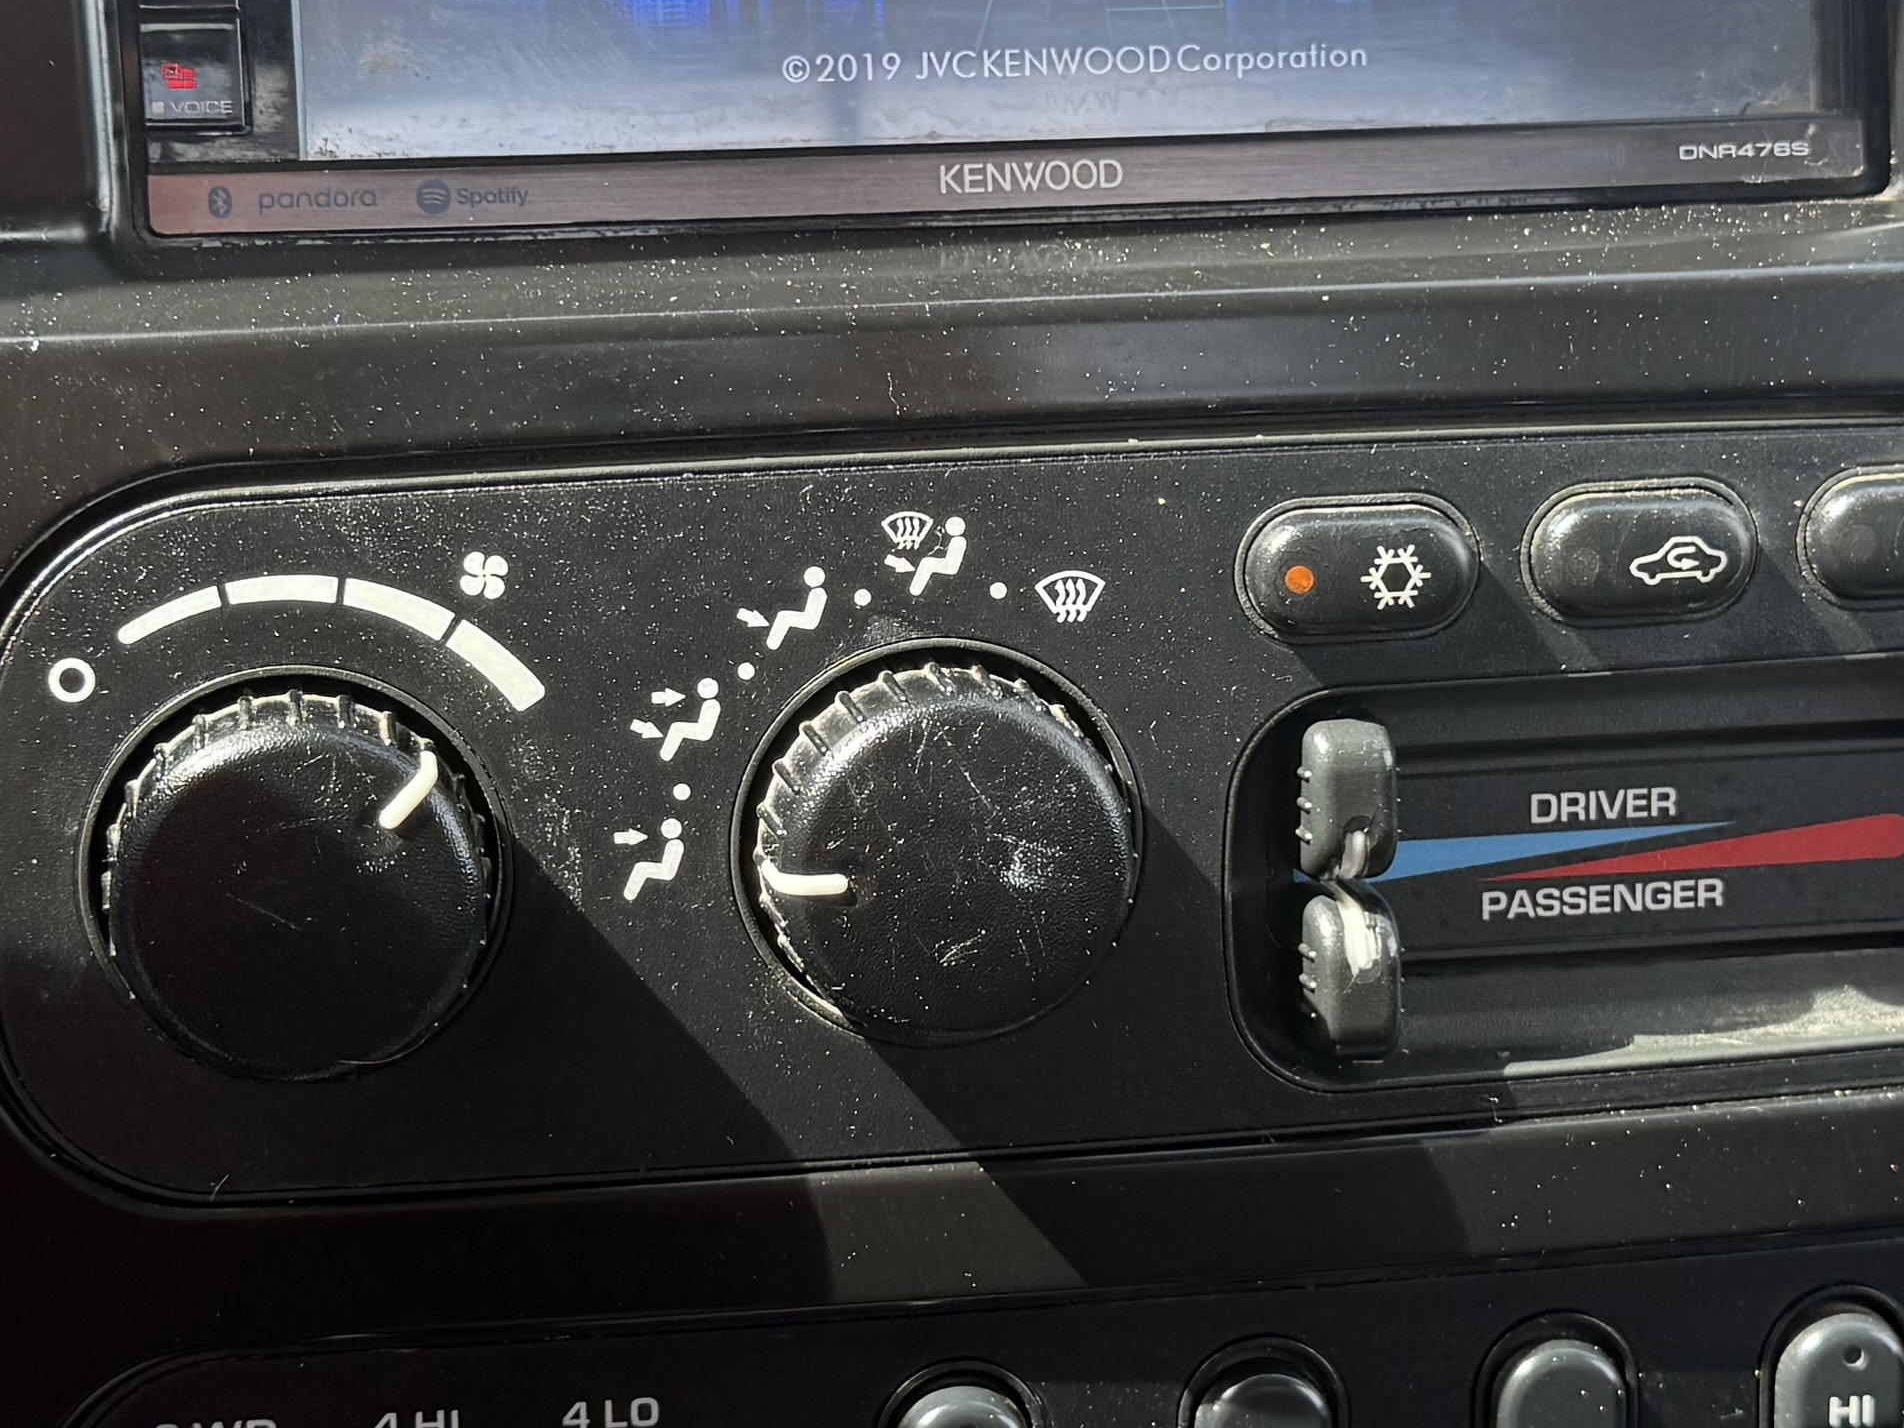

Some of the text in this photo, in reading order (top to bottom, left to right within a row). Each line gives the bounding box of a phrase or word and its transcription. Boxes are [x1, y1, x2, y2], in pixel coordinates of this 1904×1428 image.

[170, 100, 233, 116] VOICE
[1678, 140, 1810, 162] DNR476S
[939, 159, 1124, 195] KENWOOD
[257, 187, 380, 215] pandora
[457, 186, 530, 209] Spotify
[1530, 786, 1678, 824] DRIVER
[1481, 878, 1725, 922] PASSENGER
[604, 1397, 660, 1428] LO
[1828, 1394, 1875, 1428] HI
